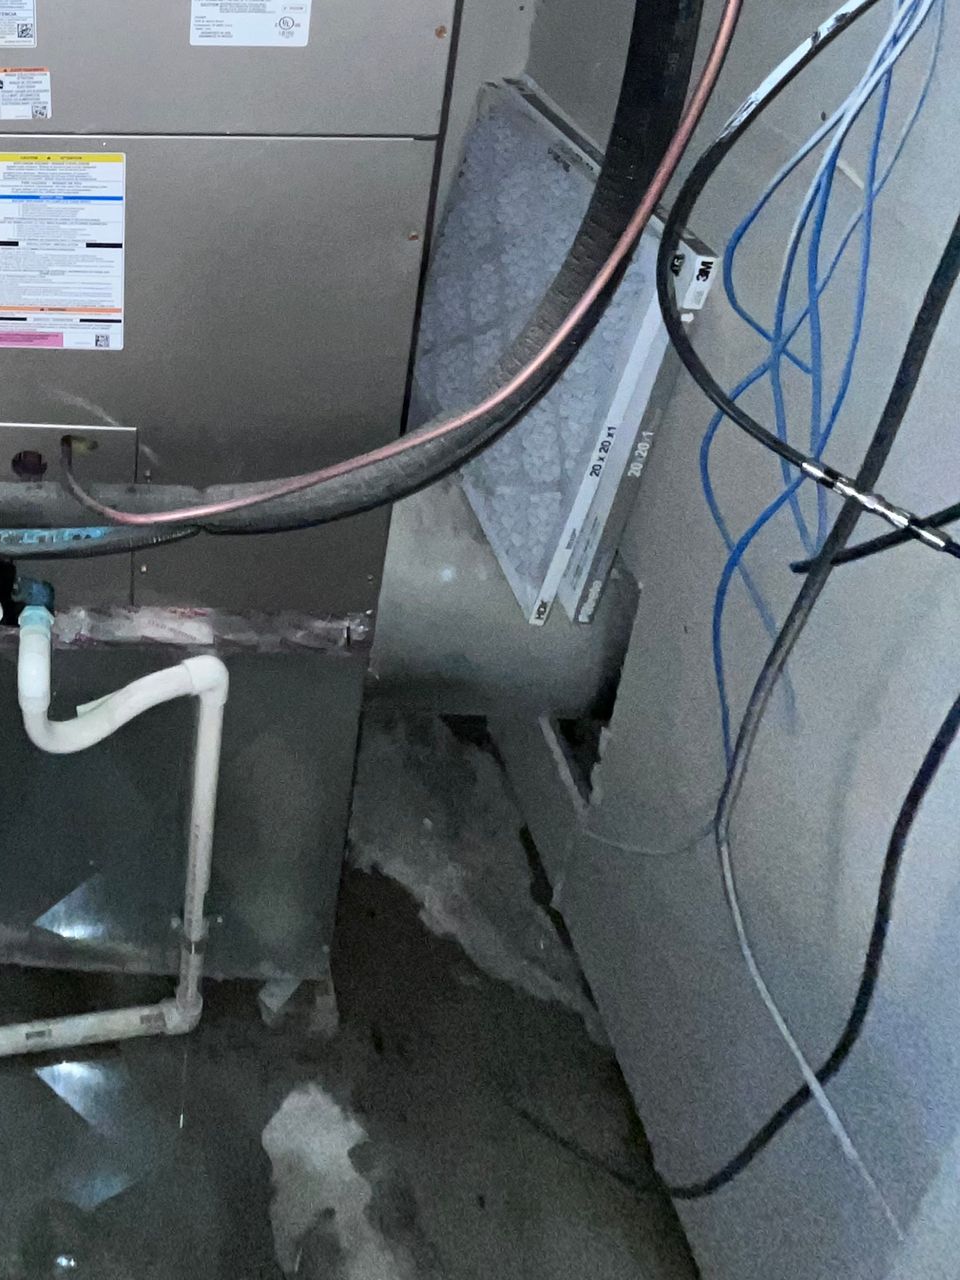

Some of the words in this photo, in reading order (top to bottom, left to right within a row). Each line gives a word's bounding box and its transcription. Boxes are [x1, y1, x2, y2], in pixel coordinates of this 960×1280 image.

[696, 261, 714, 282] 3M
[589, 464, 602, 478] 20
[598, 440, 612, 454] 20
[628, 461, 644, 478] 20
